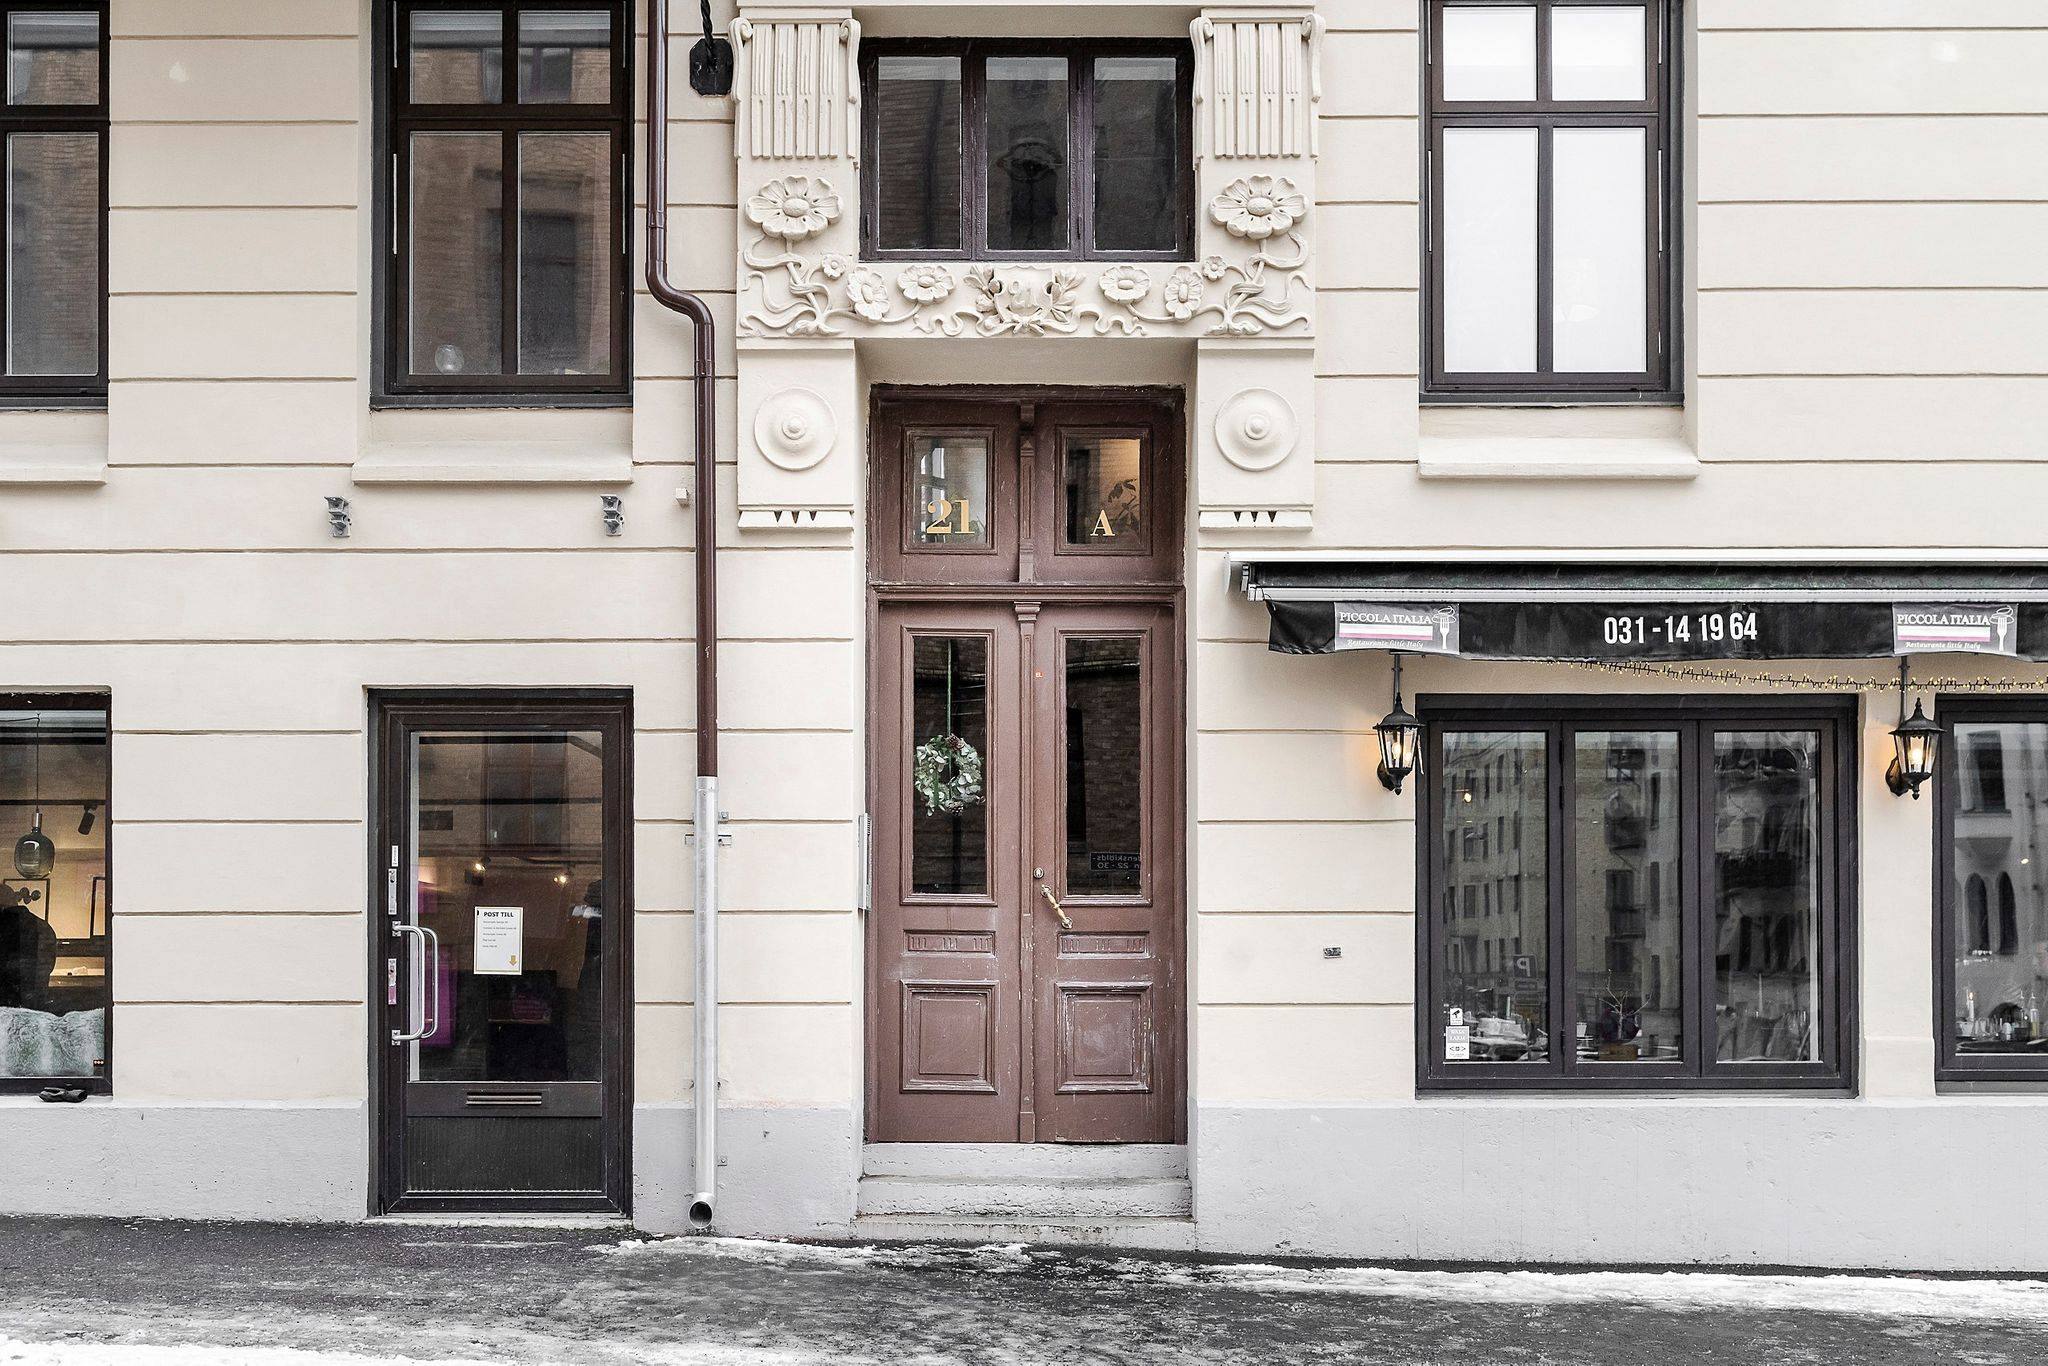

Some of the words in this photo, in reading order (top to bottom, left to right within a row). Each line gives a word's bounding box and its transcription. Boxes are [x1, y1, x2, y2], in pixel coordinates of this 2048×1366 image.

[926, 498, 975, 535] 21
[1090, 509, 1116, 536] A
[1339, 611, 1392, 623] PICCOLA
[1393, 613, 1433, 624] ITALIA
[1604, 616, 1645, 644] 031
[1699, 613, 1724, 641] 19
[1729, 612, 1758, 640] 64
[1897, 613, 1950, 625] PICCOLA
[1950, 614, 1990, 625] ITALIA
